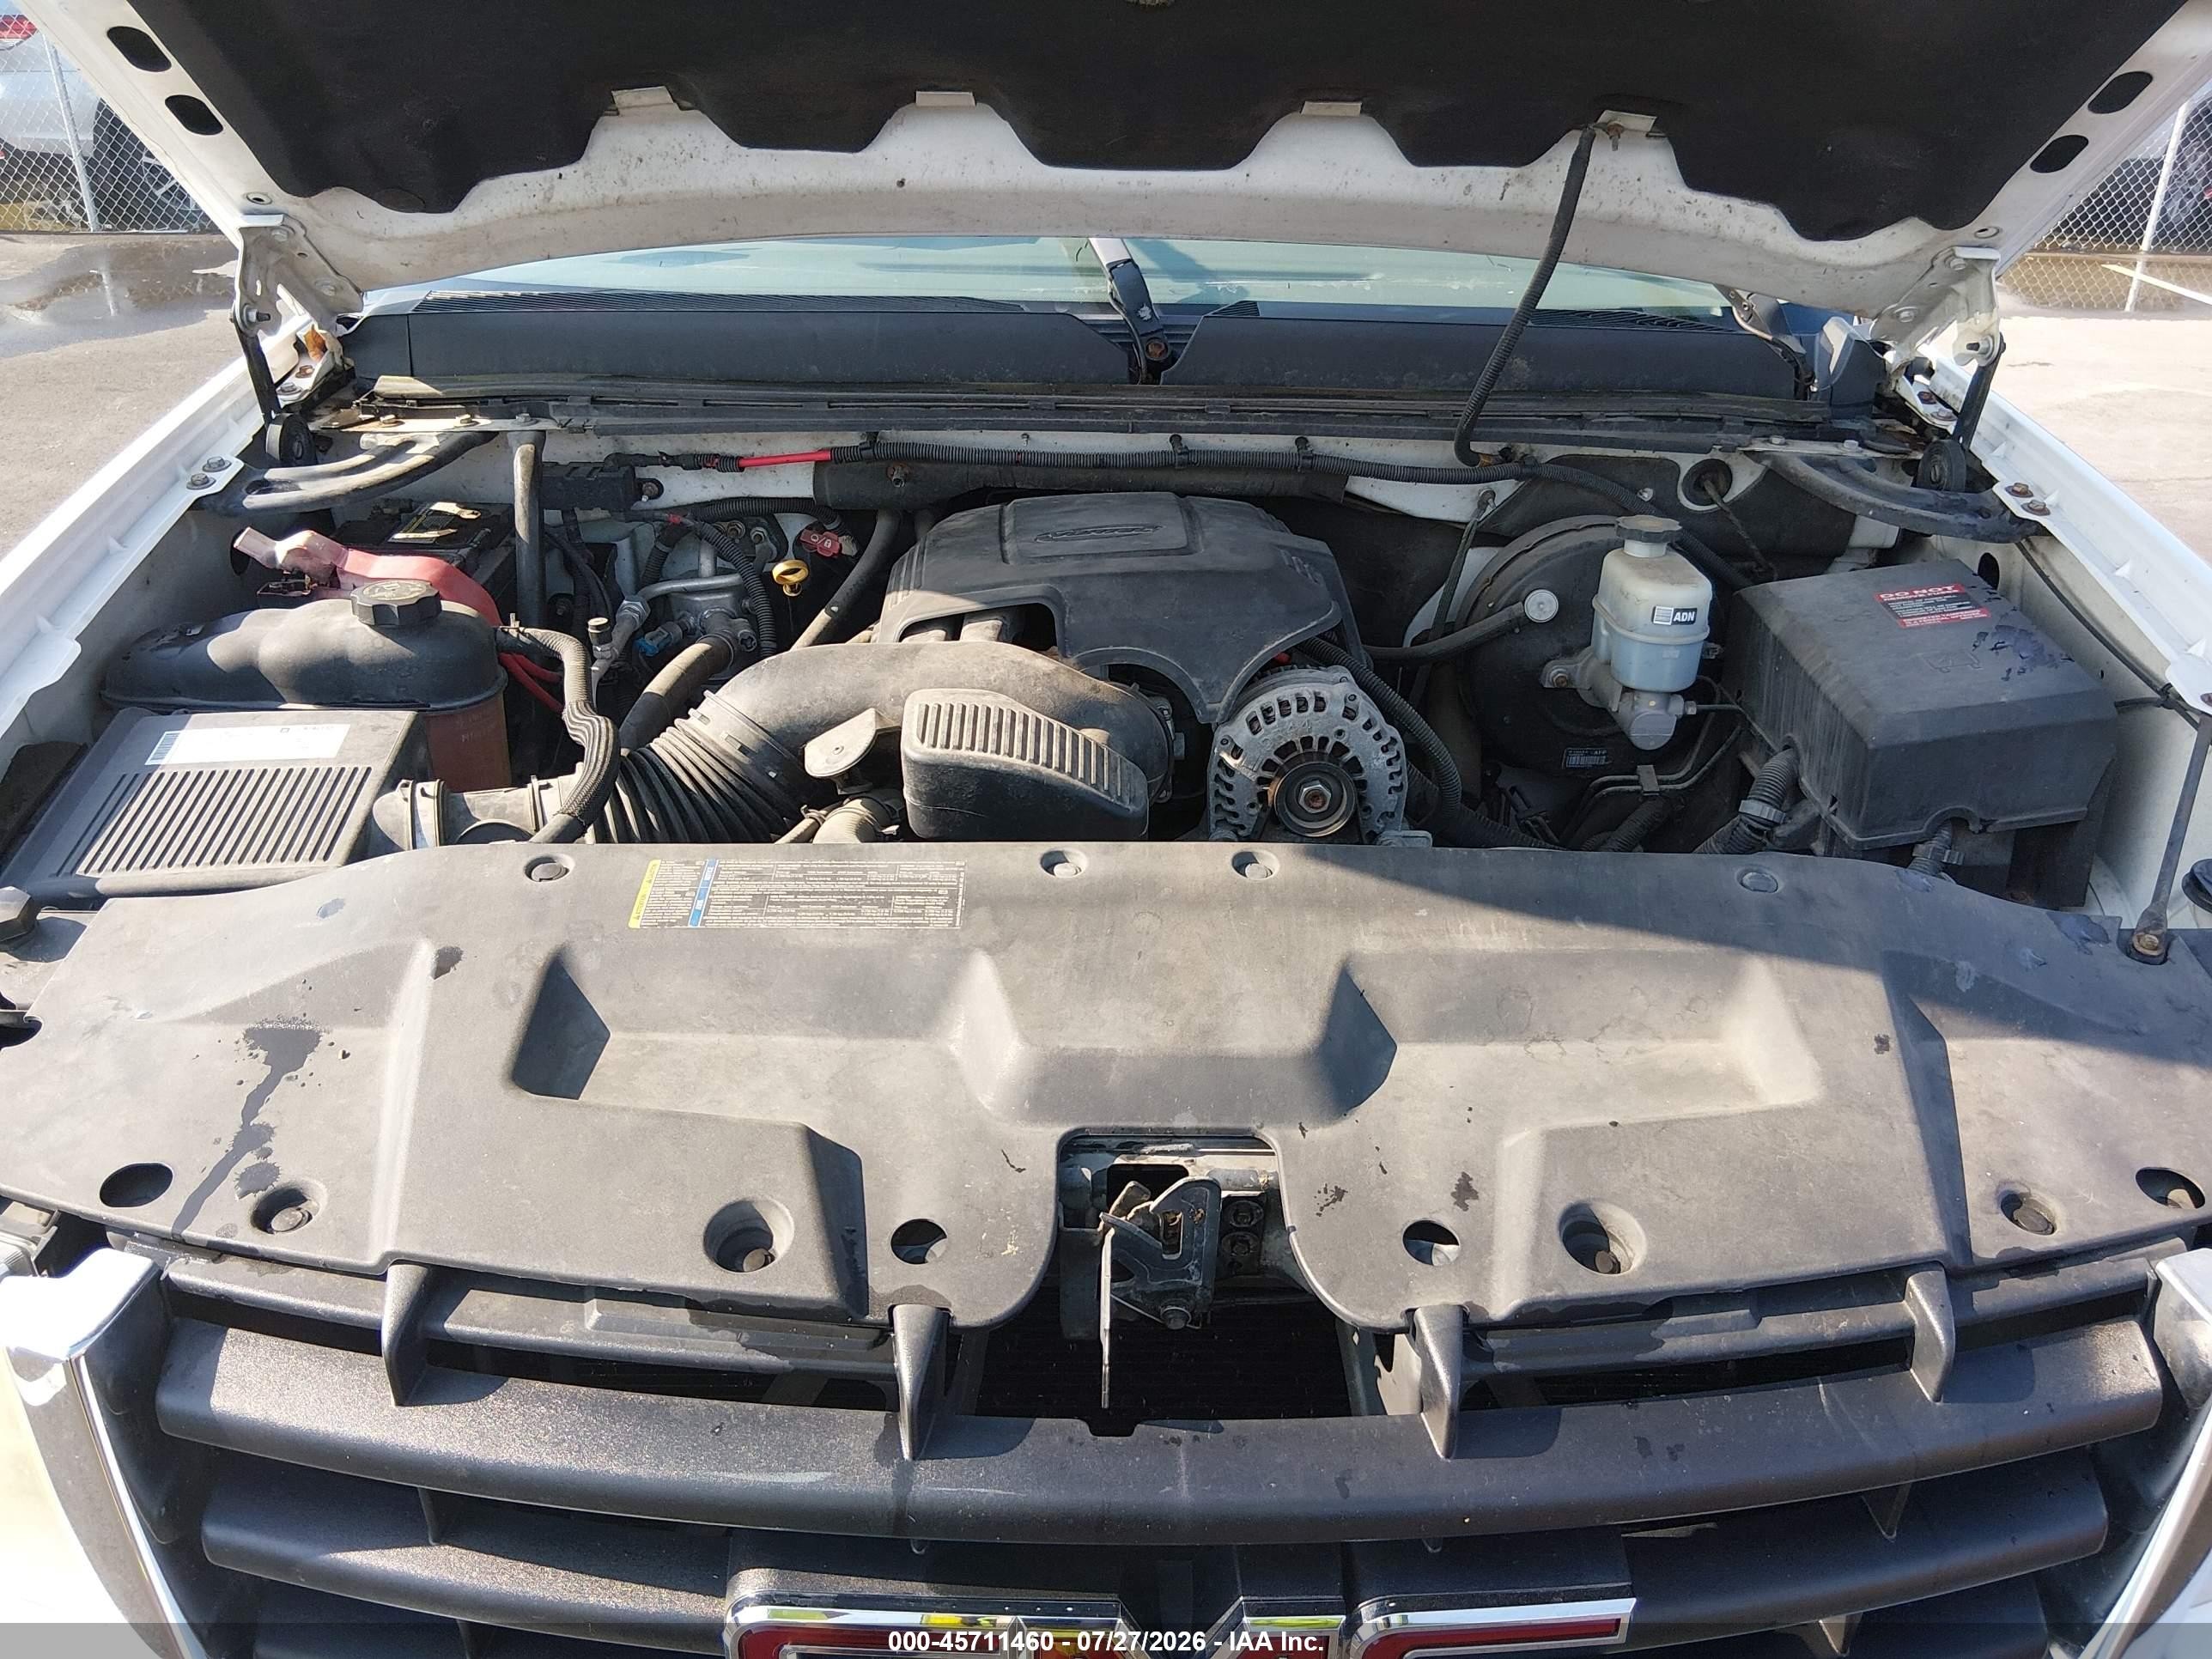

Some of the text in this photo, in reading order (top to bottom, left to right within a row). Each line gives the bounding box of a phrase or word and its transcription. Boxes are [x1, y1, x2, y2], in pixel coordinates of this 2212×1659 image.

[1880, 585, 1955, 599] DO NOT
[1673, 611, 1696, 622] ADN
